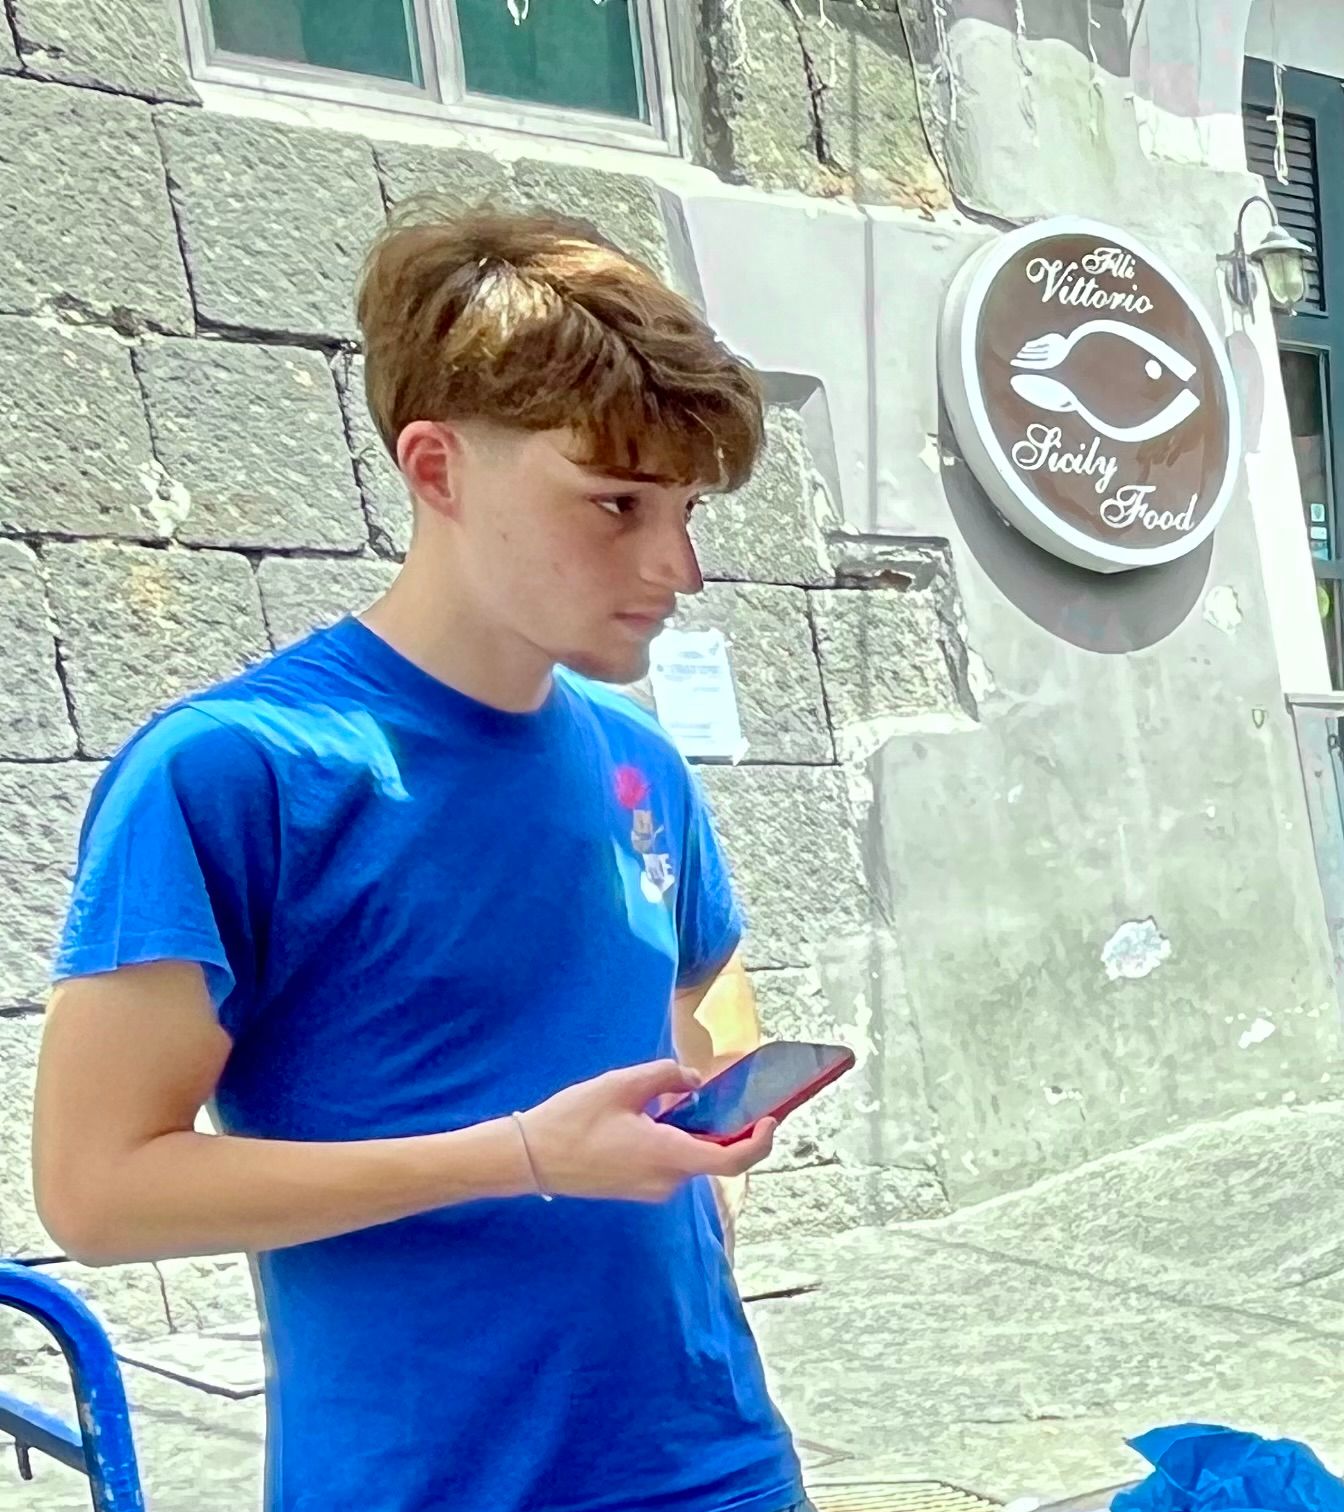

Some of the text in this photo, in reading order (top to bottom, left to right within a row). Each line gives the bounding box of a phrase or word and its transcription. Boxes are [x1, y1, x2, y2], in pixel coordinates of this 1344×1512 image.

[1026, 257, 1154, 314] Vittorio
[1011, 423, 1118, 493] Sicily
[1099, 485, 1199, 532] Food
